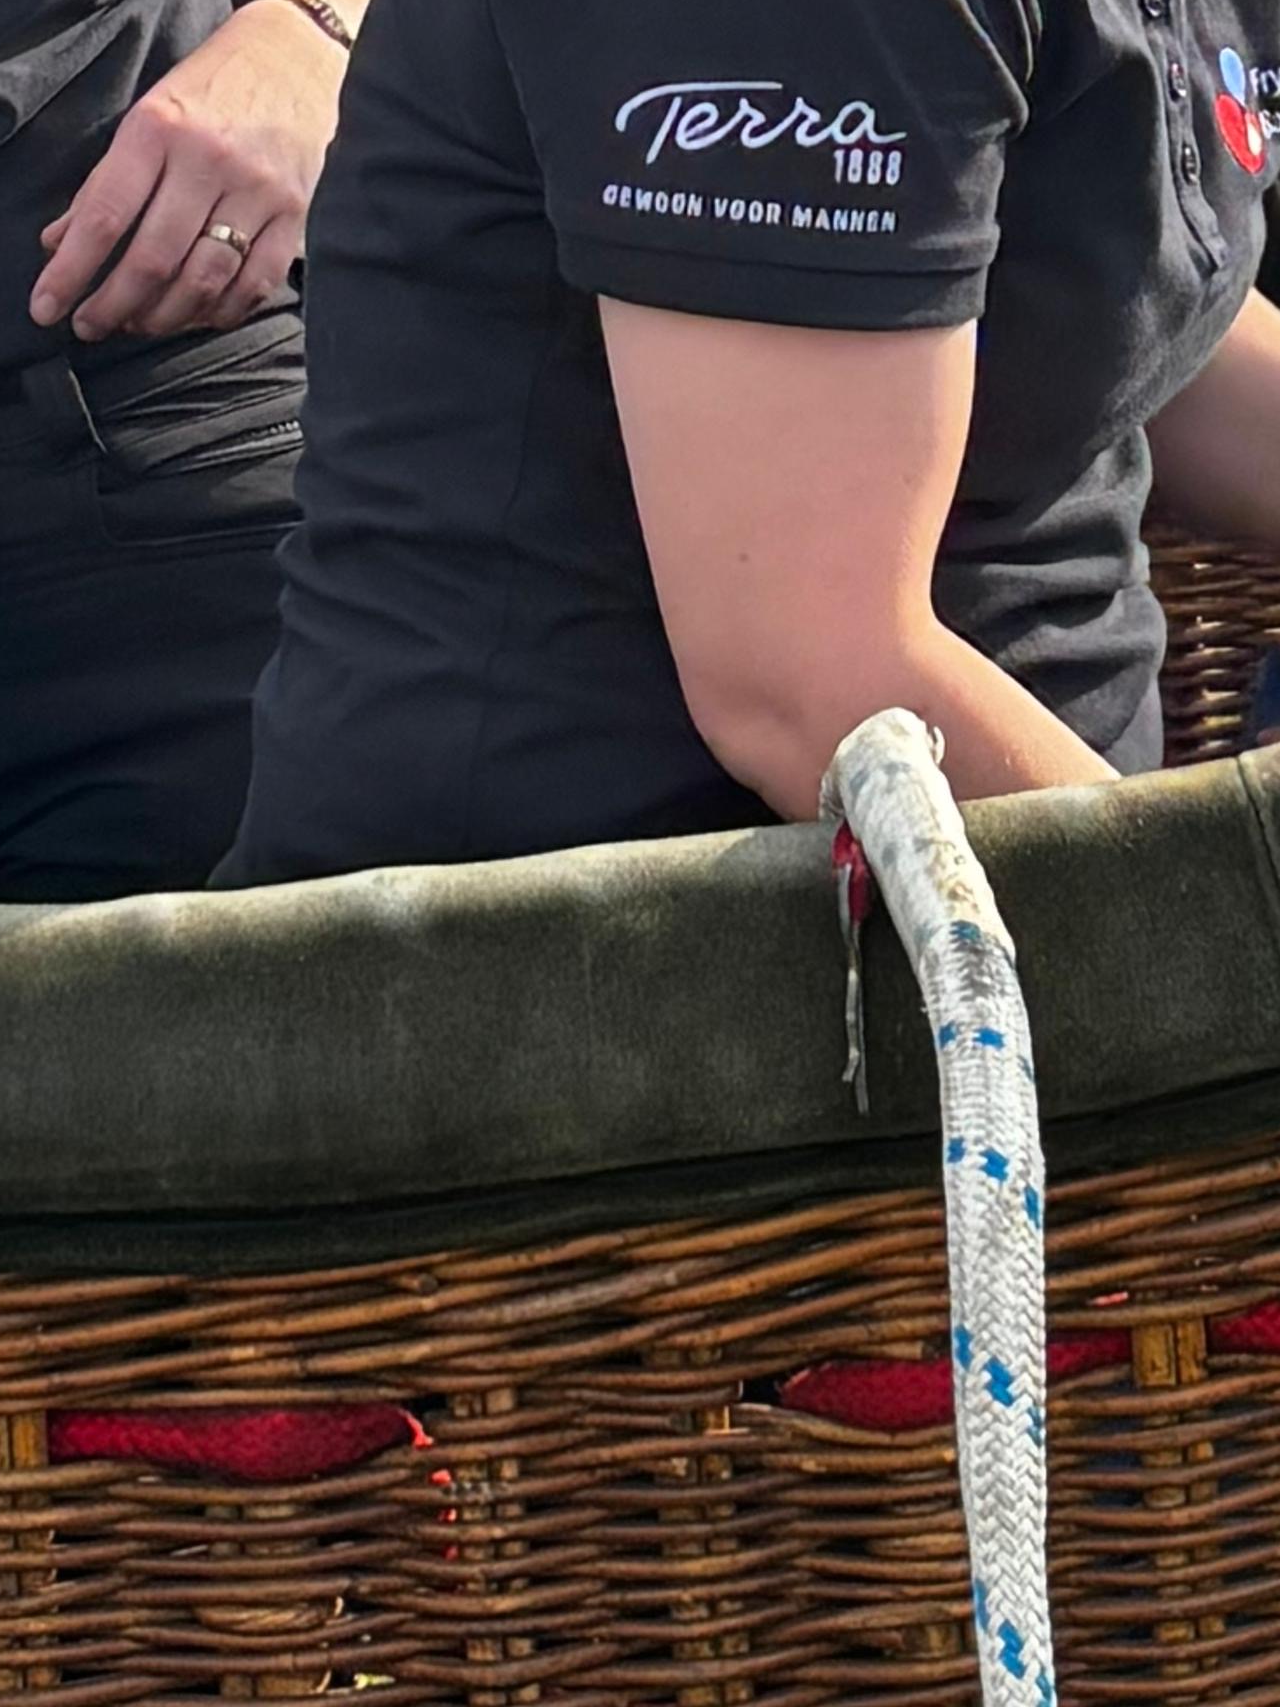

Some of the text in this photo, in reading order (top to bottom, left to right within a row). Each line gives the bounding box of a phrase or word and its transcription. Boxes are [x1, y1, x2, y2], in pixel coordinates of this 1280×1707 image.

[613, 79, 908, 165] Terra
[601, 183, 897, 233] GEWOON VOOR MANNEN
